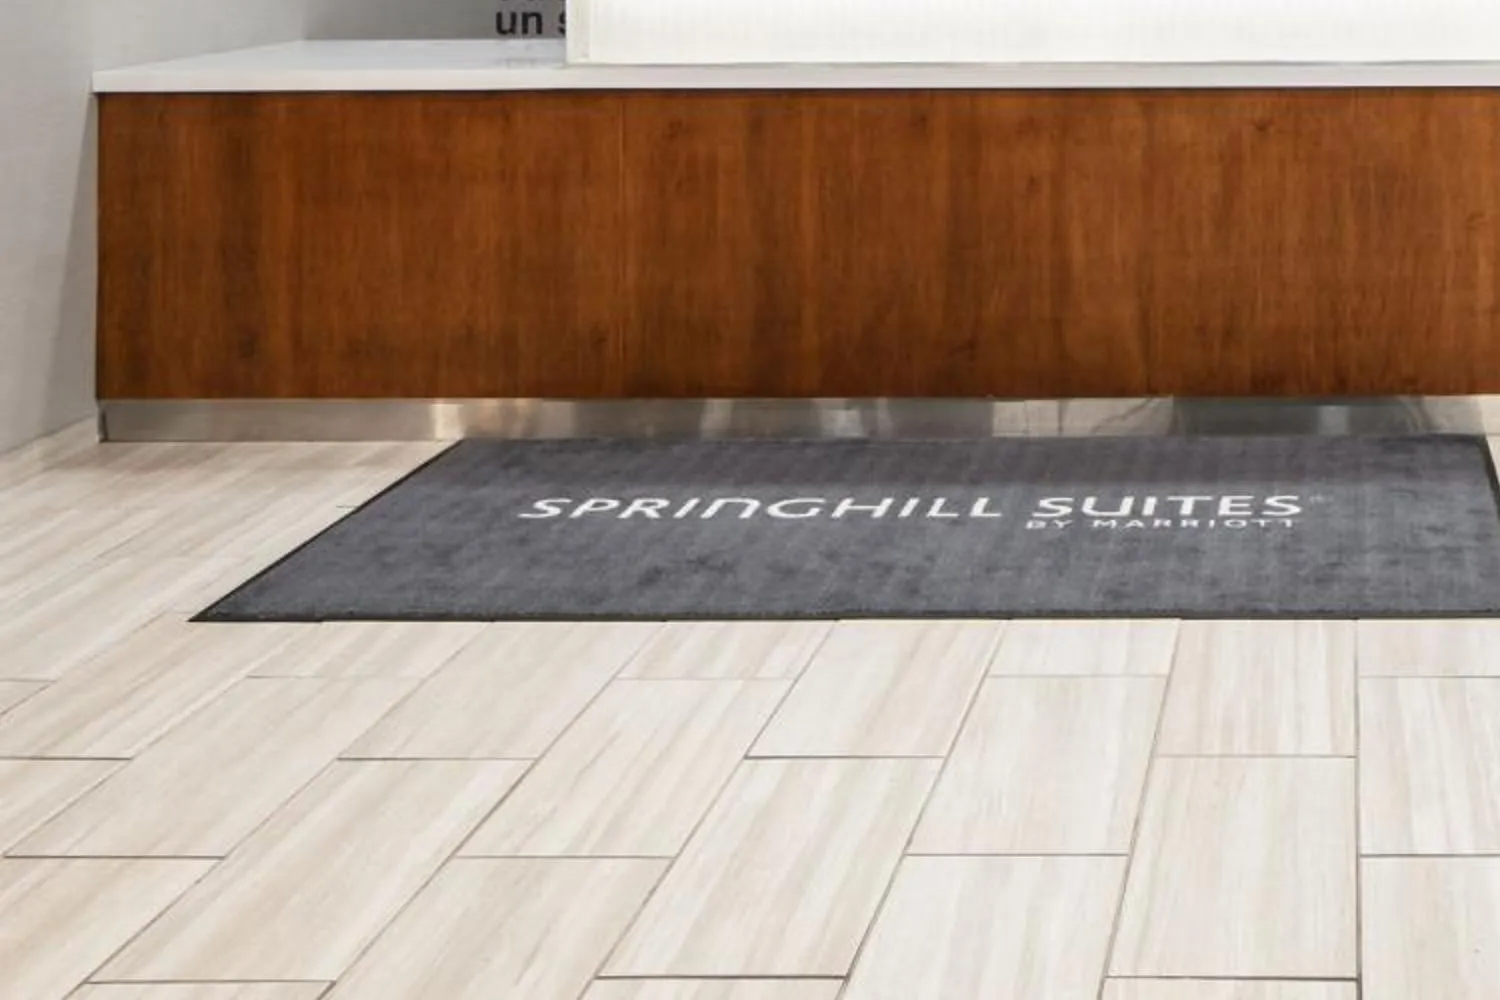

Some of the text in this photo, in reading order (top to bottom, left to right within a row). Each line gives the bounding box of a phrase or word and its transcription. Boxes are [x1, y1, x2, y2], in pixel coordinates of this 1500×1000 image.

[518, 495, 1303, 519] SPRINGHILL SUITES
[1026, 519, 1302, 529] BY MARRIOTT
